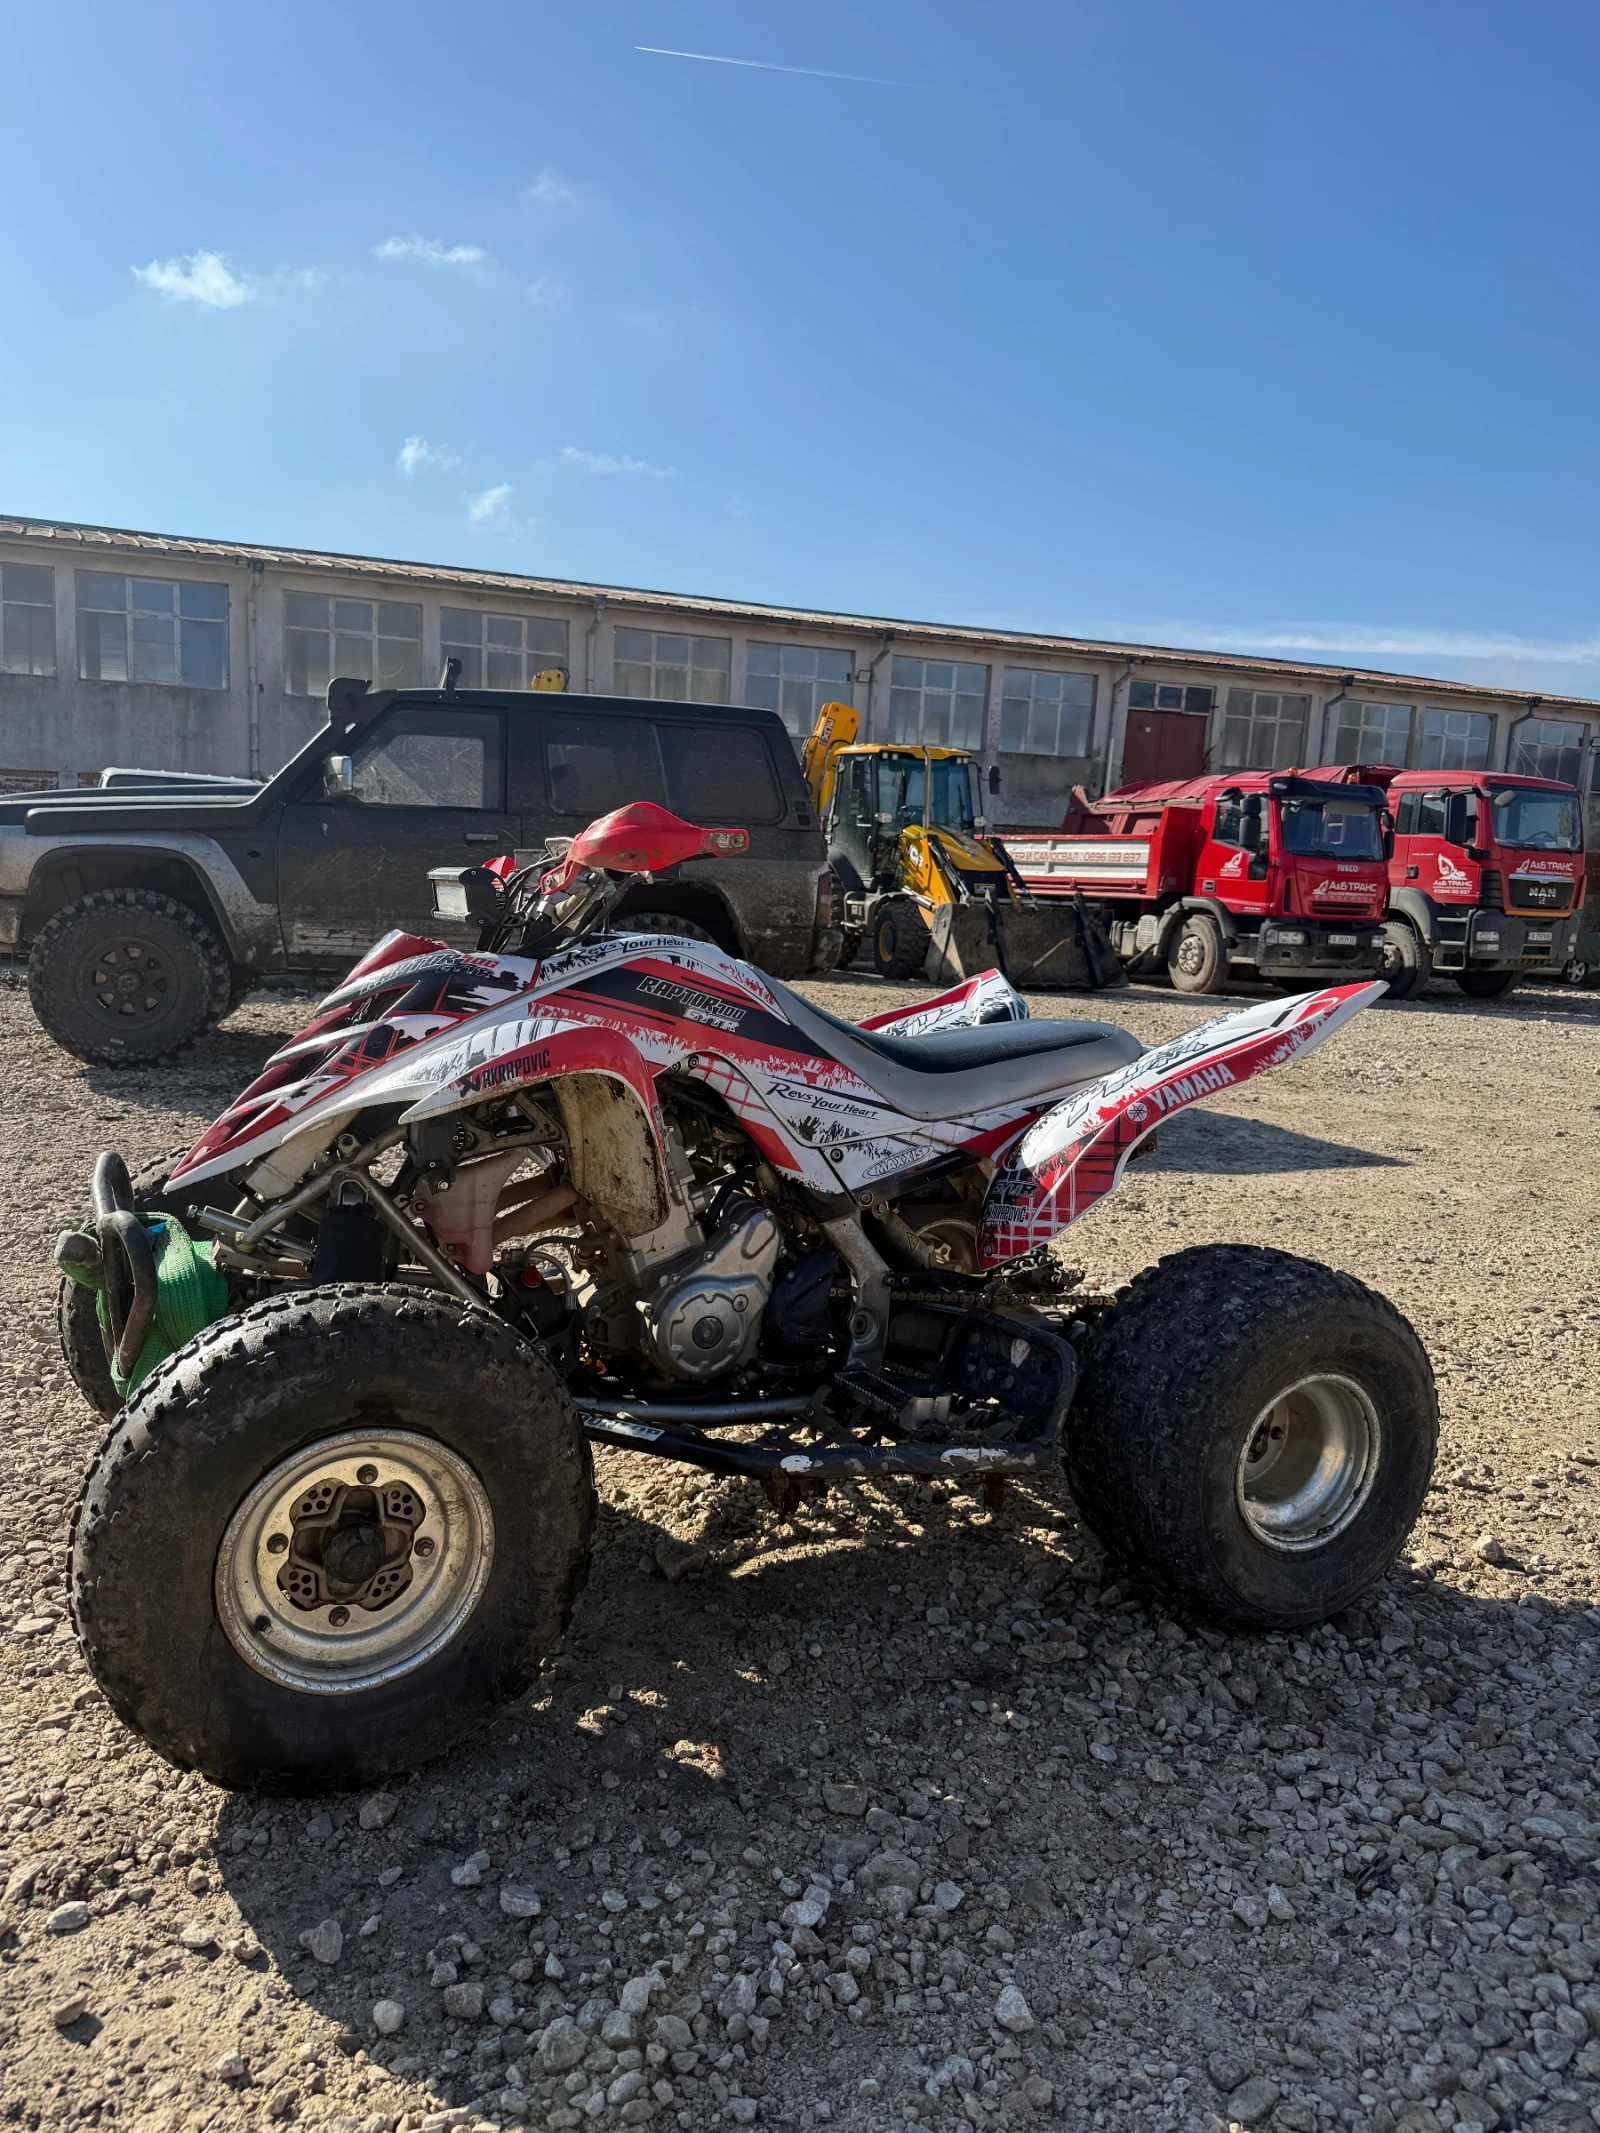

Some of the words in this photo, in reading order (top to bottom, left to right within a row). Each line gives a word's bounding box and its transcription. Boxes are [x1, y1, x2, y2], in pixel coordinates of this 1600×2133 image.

[1084, 851, 1106, 862] 0896
[1123, 852, 1141, 863] 837
[1337, 864, 1359, 873] IVECO
[1547, 861, 1573, 871] ТРАНС
[1347, 882, 1377, 893] ТРАНС
[1529, 887, 1557, 898] MAN
[620, 940, 656, 953] Your
[1146, 1063, 1237, 1111] YAMAHA
[766, 1081, 813, 1101] Revs
[811, 1095, 844, 1109] Your
[843, 1103, 879, 1117] Heart
[874, 1146, 924, 1176] MAXXIS
